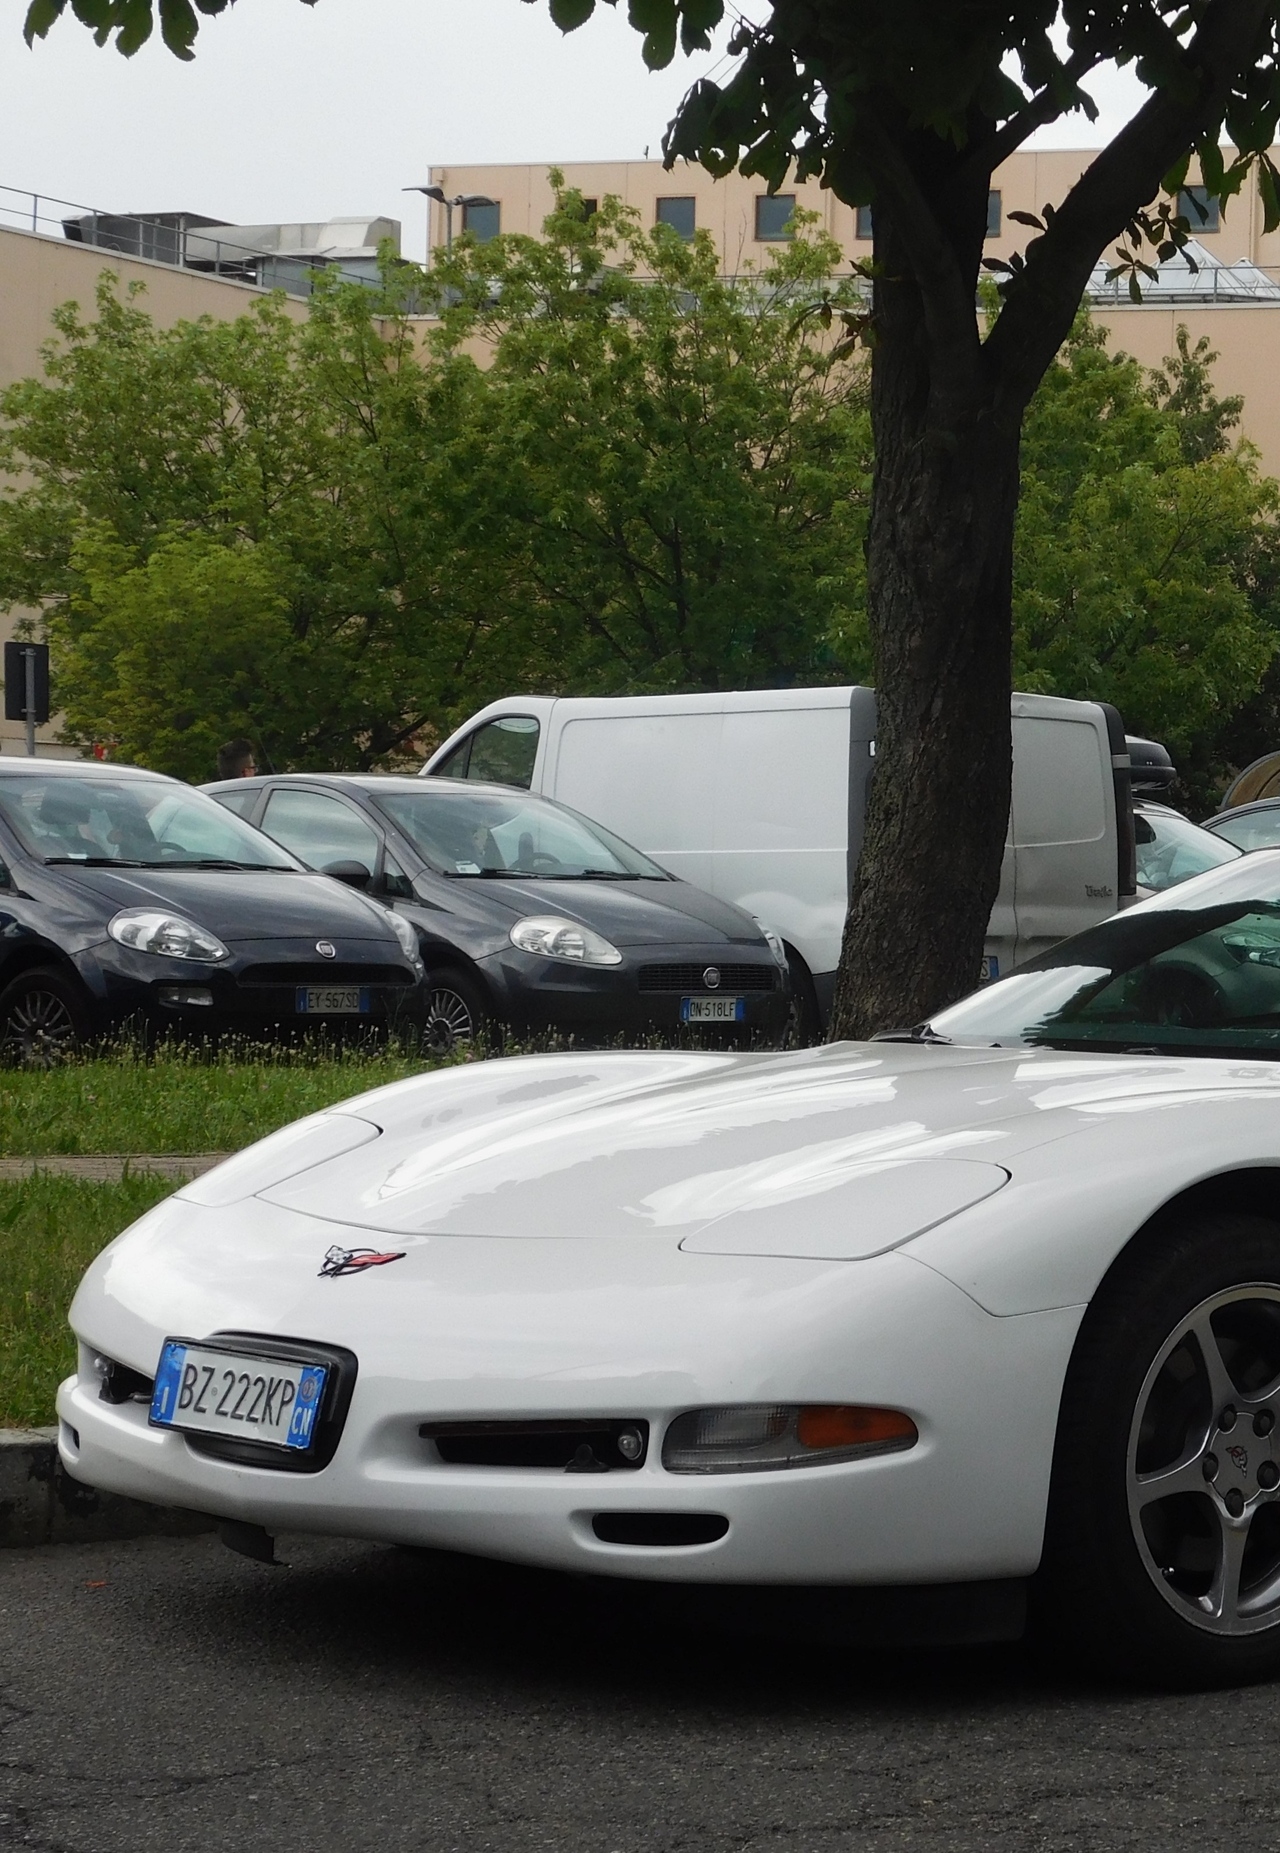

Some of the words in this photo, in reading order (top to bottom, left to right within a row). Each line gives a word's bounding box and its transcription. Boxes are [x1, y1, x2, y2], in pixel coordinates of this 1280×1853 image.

[308, 992, 322, 1008] EY
[325, 992, 359, 1008] 567SD
[704, 1002, 736, 1017] 518LF
[178, 1363, 216, 1414] BZ
[215, 1370, 297, 1426] 222KP
[291, 1406, 312, 1436] CN
